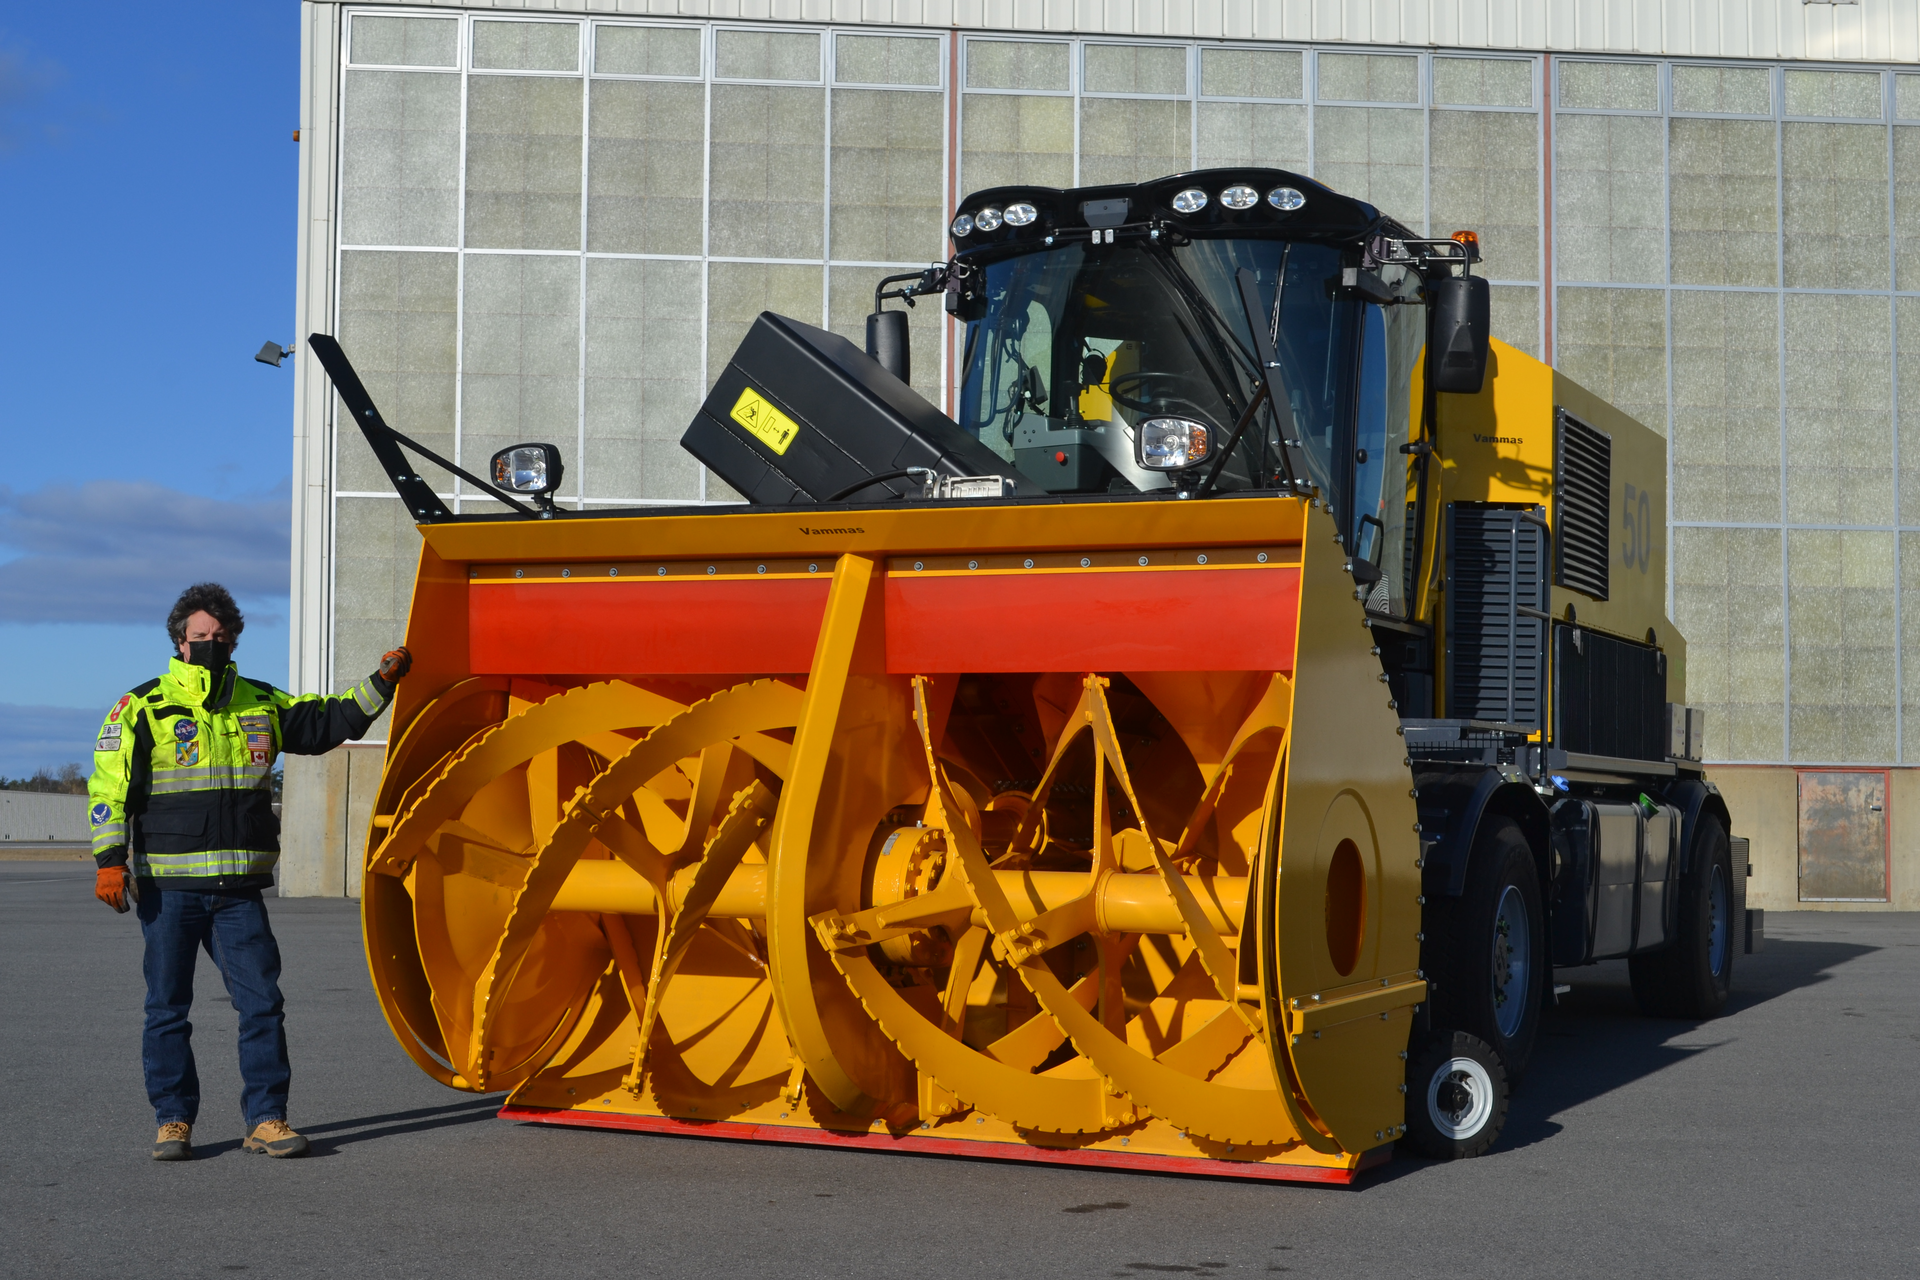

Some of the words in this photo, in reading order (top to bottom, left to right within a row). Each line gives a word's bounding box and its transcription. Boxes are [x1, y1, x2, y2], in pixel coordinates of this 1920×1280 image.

[1473, 433, 1524, 445] Vammas
[799, 527, 865, 535] Vammas
[1622, 482, 1651, 575] 50
